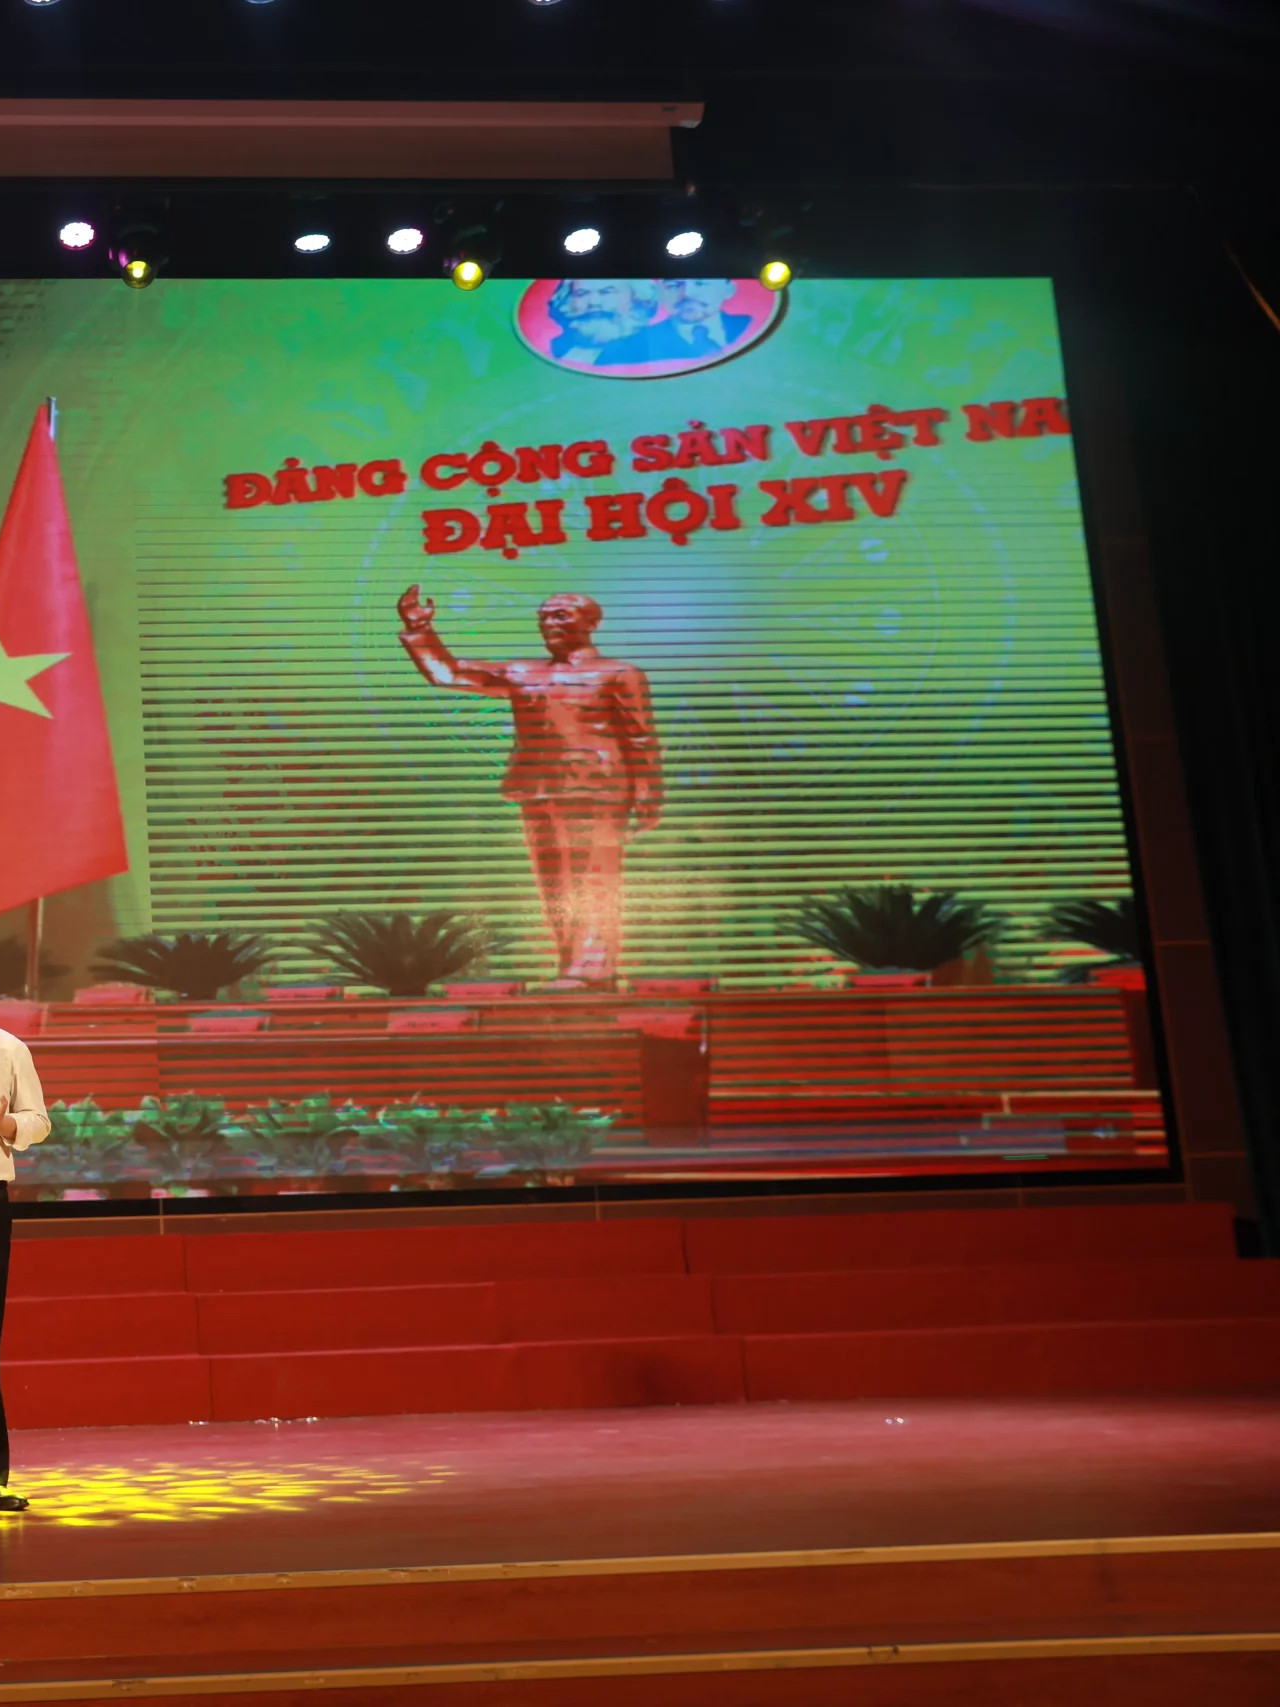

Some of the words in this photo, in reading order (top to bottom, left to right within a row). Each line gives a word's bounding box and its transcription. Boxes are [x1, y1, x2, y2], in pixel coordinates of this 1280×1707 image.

[224, 457, 406, 509] ĐẢNG
[420, 441, 614, 497] CỘNG
[631, 420, 771, 472] SẢN
[785, 404, 949, 460] VIỆT
[421, 498, 567, 559] ĐẠI
[584, 477, 741, 546] HỘI
[759, 469, 908, 527] XIV
